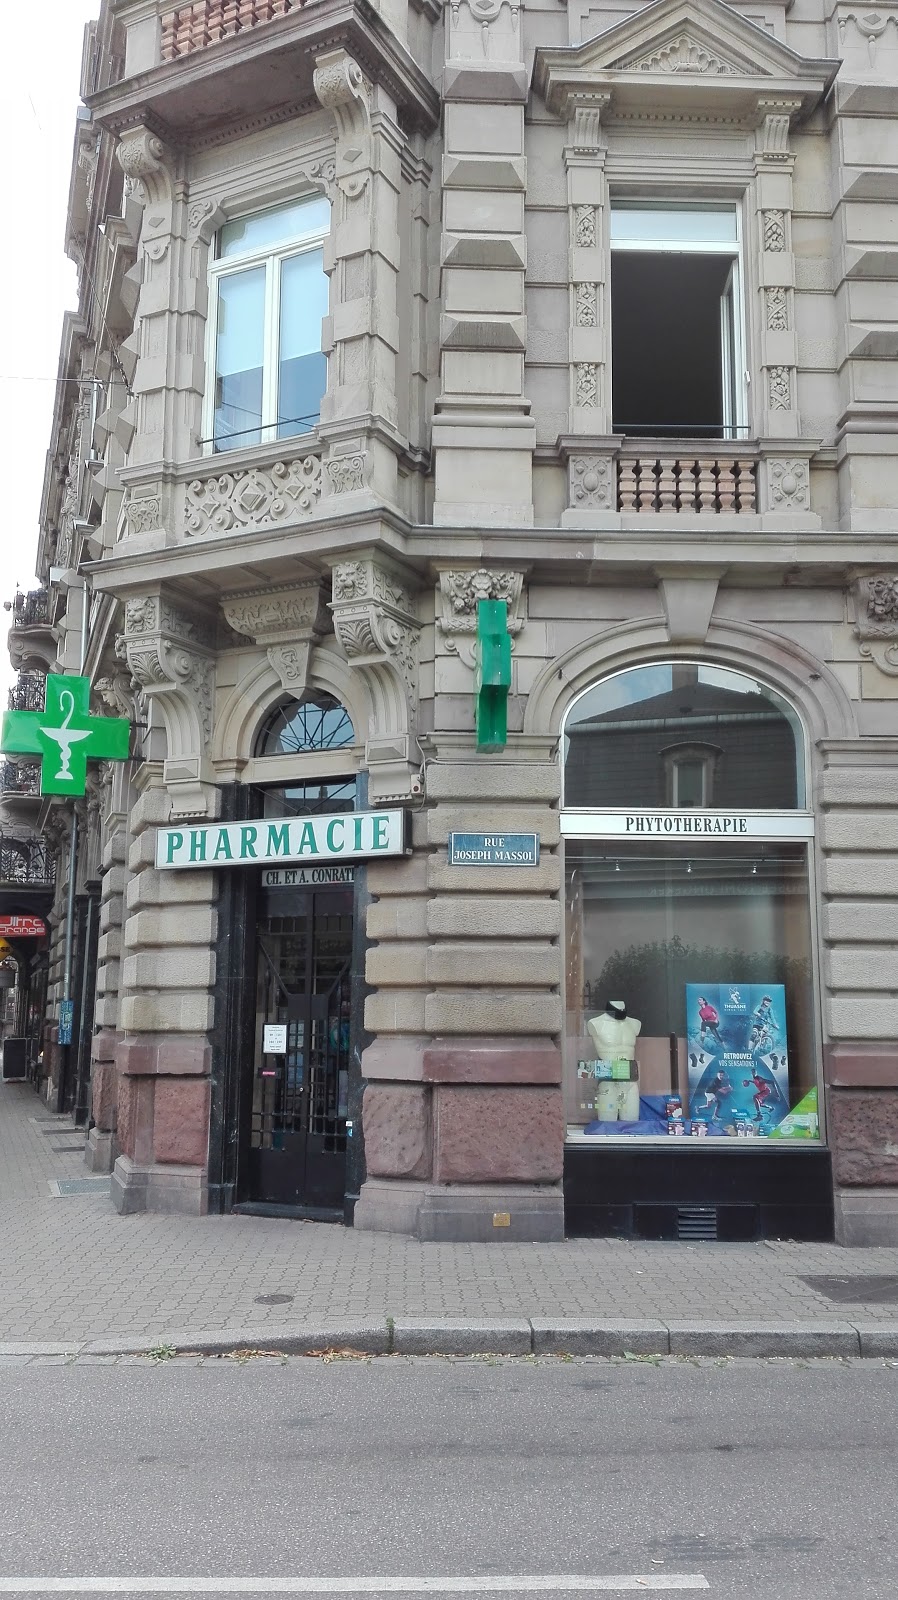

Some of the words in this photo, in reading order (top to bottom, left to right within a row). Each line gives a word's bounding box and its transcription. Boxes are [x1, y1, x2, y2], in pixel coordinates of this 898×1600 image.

[625, 817, 748, 833] PHYTOTHERAPIE
[165, 815, 391, 864] PHARMACIE
[484, 837, 505, 848] RUE
[454, 850, 492, 861] JOSEPH
[494, 851, 535, 862] MASSOL
[266, 871, 282, 886] CH.
[284, 870, 298, 884] ET
[299, 870, 309, 884] A.
